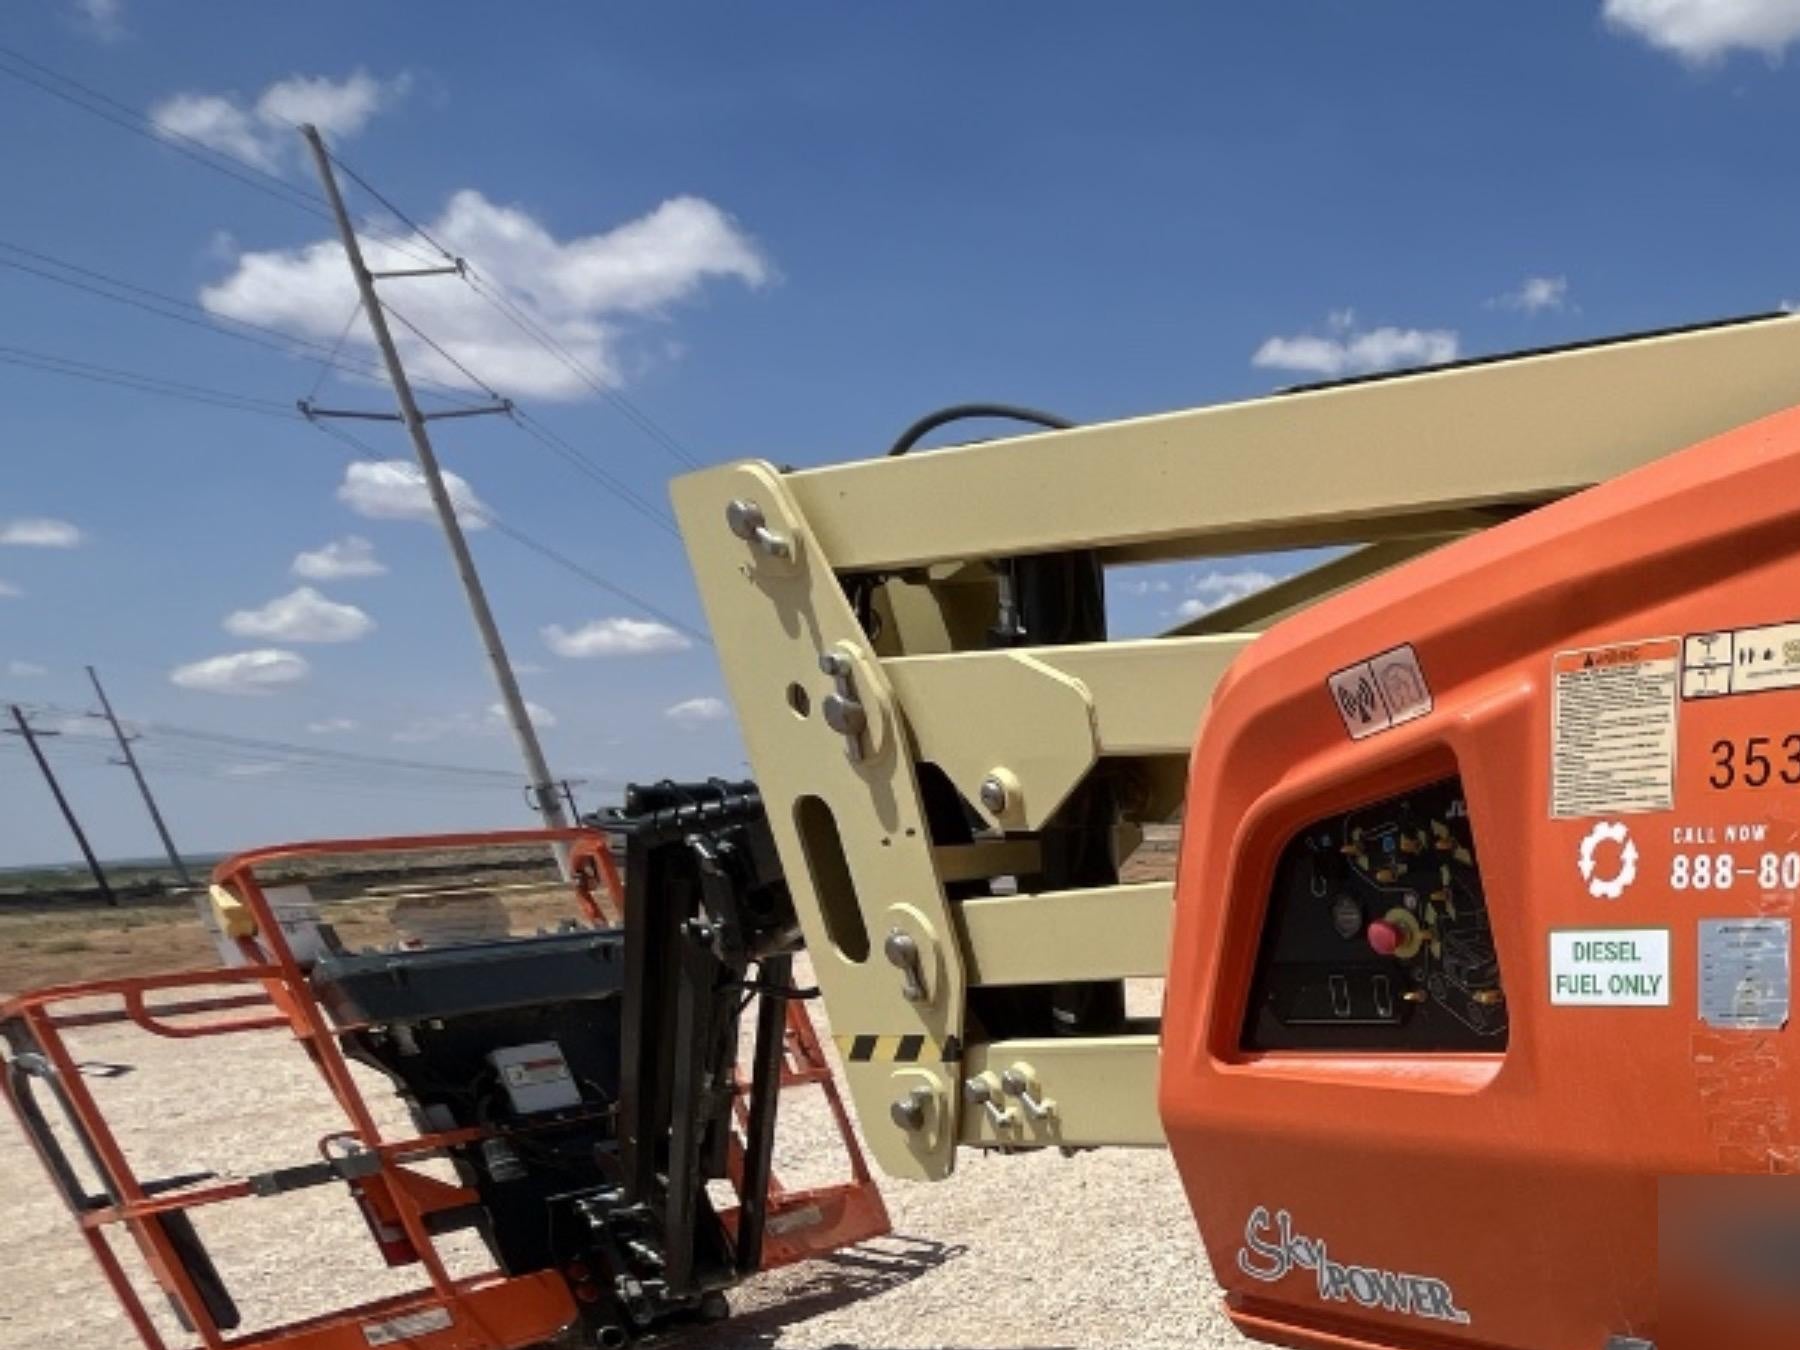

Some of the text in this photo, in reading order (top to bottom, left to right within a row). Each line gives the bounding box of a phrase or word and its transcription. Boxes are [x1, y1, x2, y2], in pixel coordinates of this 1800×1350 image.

[1672, 823, 1770, 845] CALL NOW
[1572, 941, 1642, 963] DIESEL
[1555, 973, 1664, 996] FUEL ONLY
